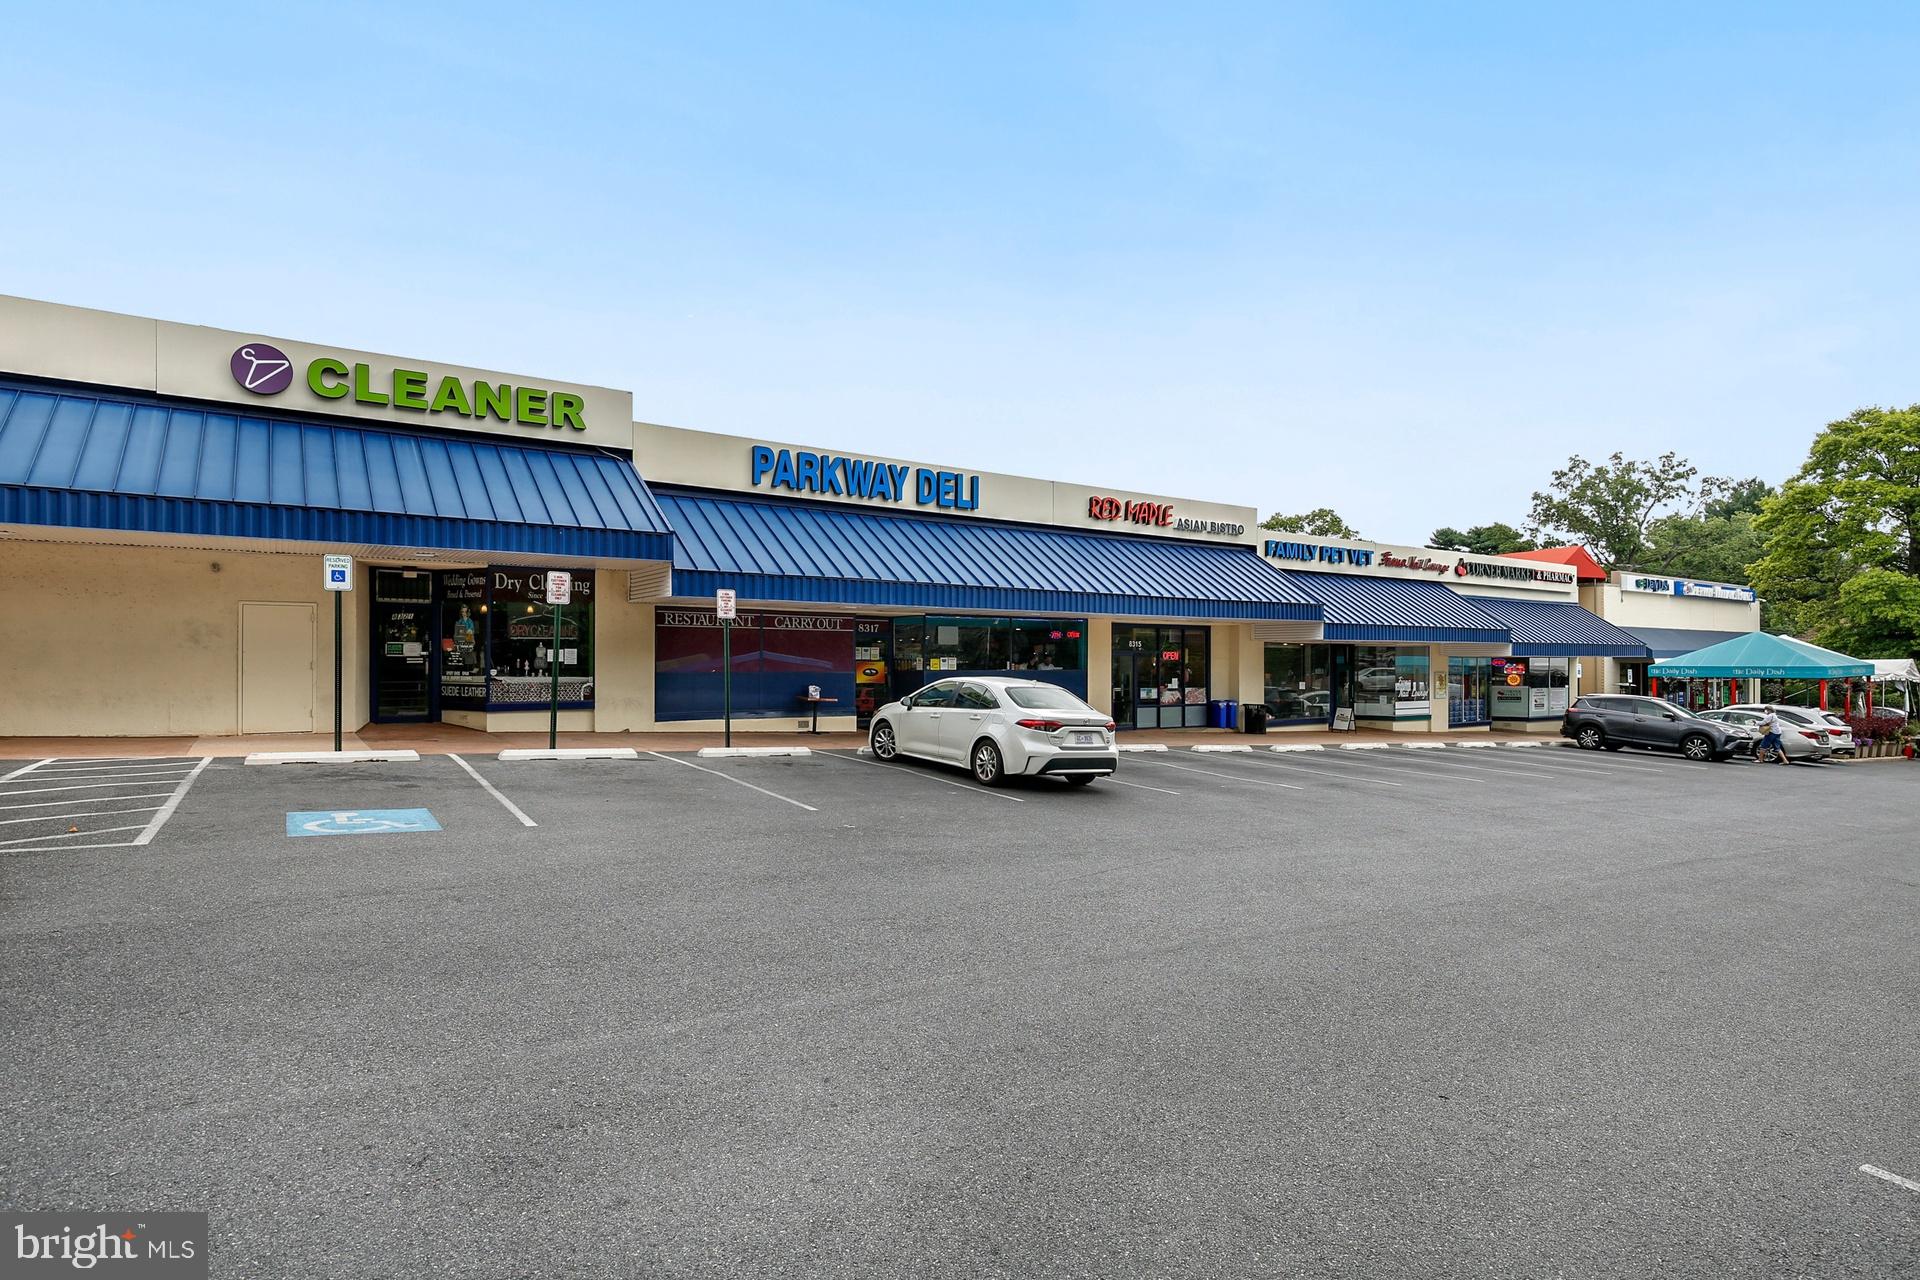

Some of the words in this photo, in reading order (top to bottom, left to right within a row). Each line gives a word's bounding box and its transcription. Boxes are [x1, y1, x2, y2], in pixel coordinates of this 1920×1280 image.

[306, 357, 587, 431] CLEANER
[751, 445, 909, 502] PARKWAY
[916, 467, 979, 510] DELI
[1088, 495, 1122, 521] RED
[1124, 499, 1174, 527] MAPLE
[1176, 517, 1208, 531] ASIAN
[1210, 521, 1245, 536] BISTRO
[1265, 540, 1319, 561] FAMILY
[1319, 545, 1347, 564] PET
[1349, 549, 1375, 567] VET
[467, 573, 486, 585] Gowns
[1465, 561, 1501, 580] CORNER
[1501, 564, 1535, 582] MARKET
[1536, 570, 1542, 580] &
[1542, 570, 1575, 584] PHARMACY
[494, 573, 523, 593] Dry
[528, 574, 590, 595] Cling
[774, 616, 815, 629] CARRY
[816, 617, 843, 630] OUT
[858, 624, 880, 633] 8317
[1128, 640, 1142, 648] 8315
[1162, 651, 1179, 661] OPEN
[1745, 668, 1765, 676] Daily
[1766, 668, 1785, 676] Dish
[441, 685, 460, 696] SUEDE
[461, 686, 487, 697] LEATHER
